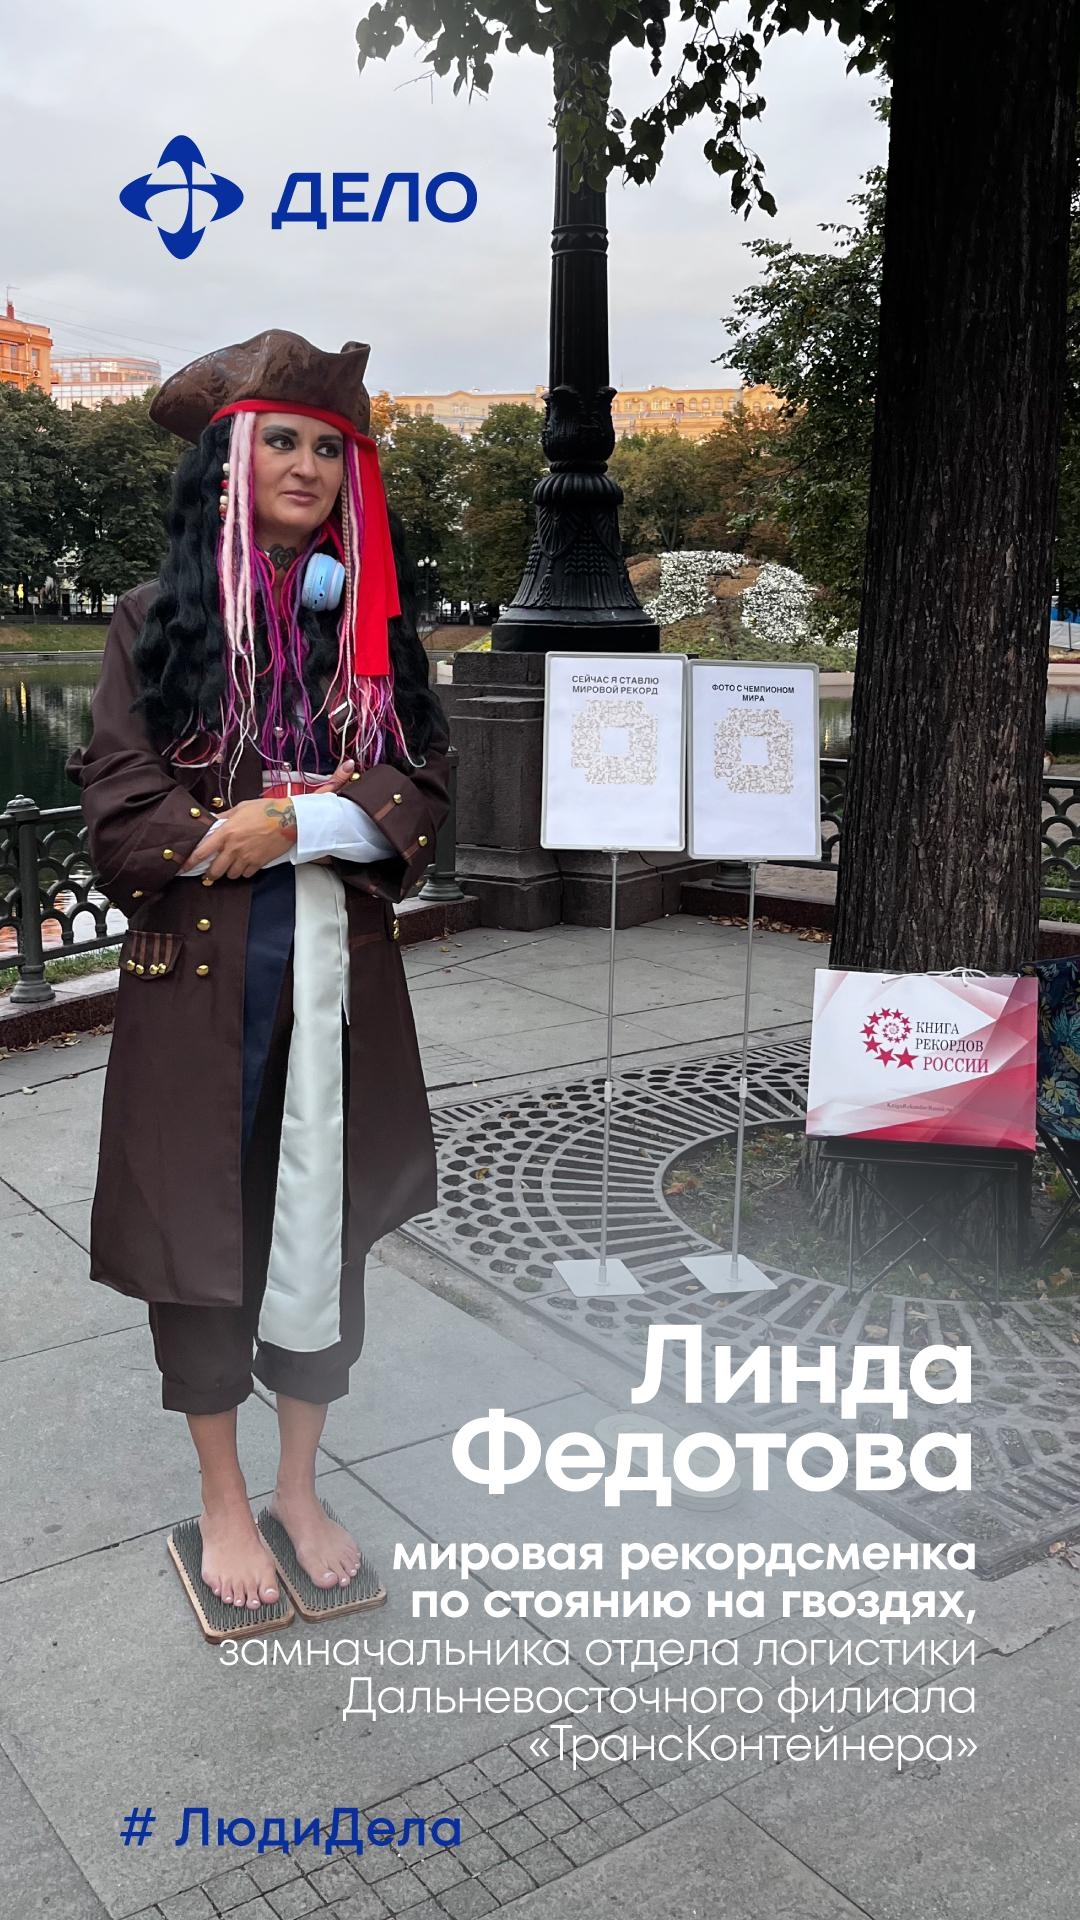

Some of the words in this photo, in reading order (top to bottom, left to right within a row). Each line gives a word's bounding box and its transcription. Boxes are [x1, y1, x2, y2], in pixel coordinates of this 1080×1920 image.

[571, 673, 609, 684] СЕЙЧАС
[611, 676, 618, 684] Я
[619, 676, 659, 685] СТАВЛЮ
[572, 684, 619, 694] МИРОВОЙ
[620, 686, 658, 695] РЕКОРД
[711, 683, 735, 692] ФОТО
[736, 684, 742, 692] С
[743, 685, 795, 694] ЧЕМПИОНОМ
[742, 694, 765, 702] МИРА
[916, 1021, 960, 1035] КНИГА
[915, 1038, 984, 1053] РЕКОРДОВ
[923, 1056, 989, 1073] РОССИИ
